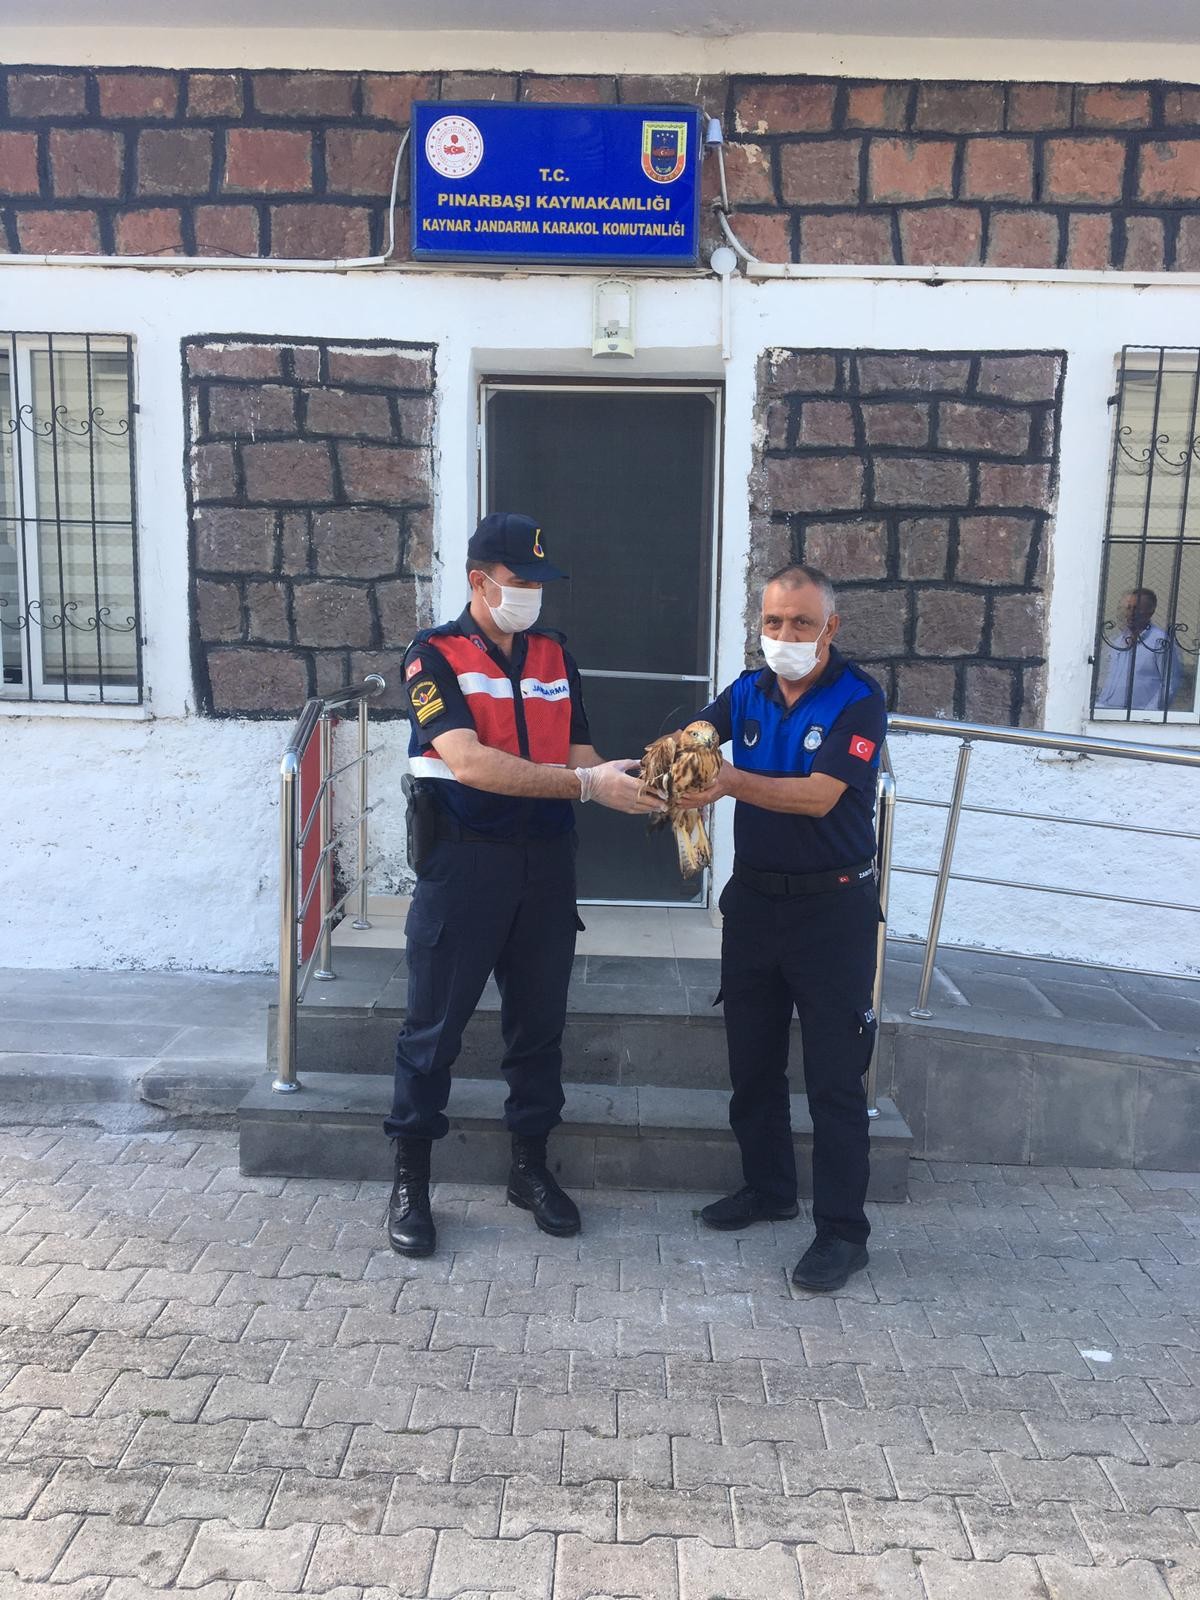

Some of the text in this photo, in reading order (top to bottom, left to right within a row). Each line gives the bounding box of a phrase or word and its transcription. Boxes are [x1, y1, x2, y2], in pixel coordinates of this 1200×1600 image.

[538, 168, 570, 182] T.C.
[437, 193, 671, 212] PINARBAŞI KAYMAKAMLIĞI
[422, 218, 685, 237] KAYNAR JANDARMA KARAKOL KOMUTANLIĞI
